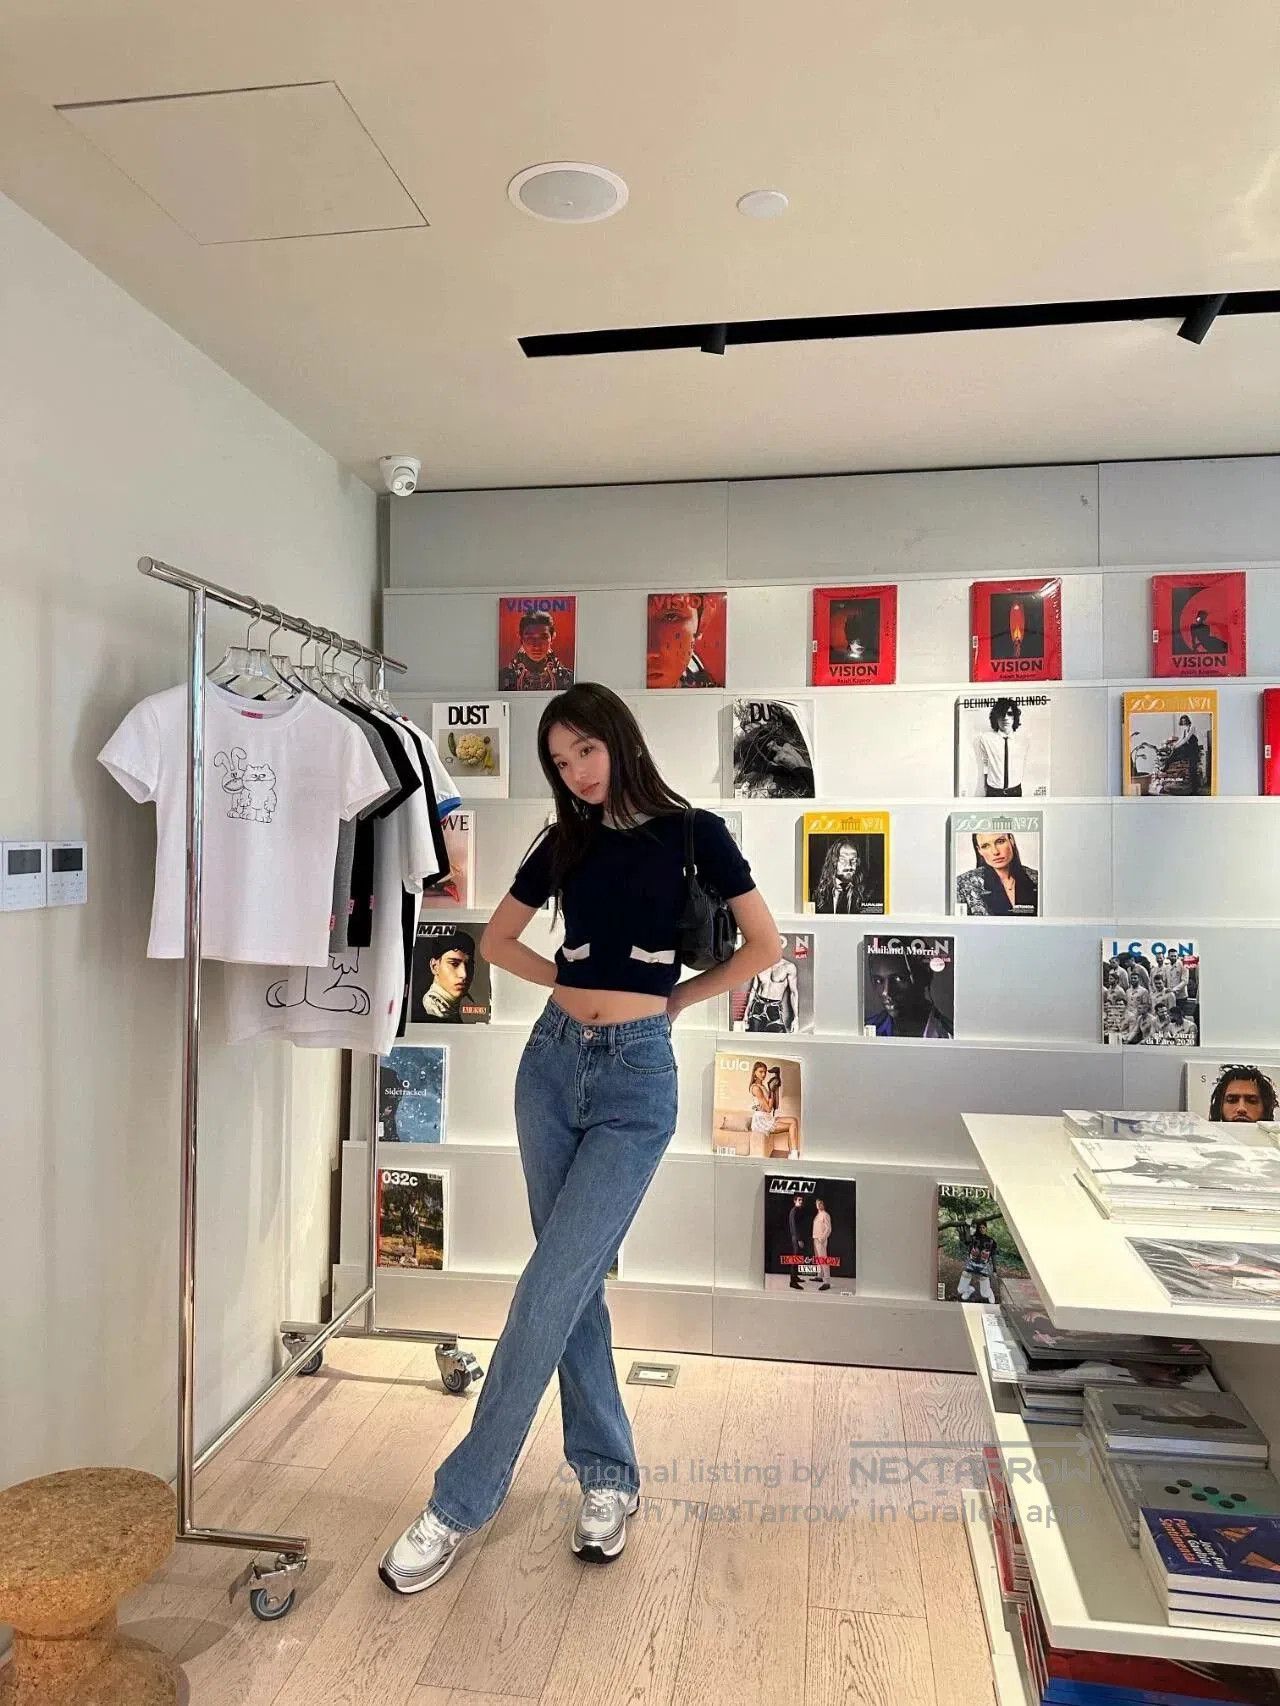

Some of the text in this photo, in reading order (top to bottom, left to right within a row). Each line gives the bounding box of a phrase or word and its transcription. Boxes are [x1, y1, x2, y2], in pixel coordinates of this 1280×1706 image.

[507, 599, 567, 613] VISION
[990, 659, 1043, 673] VISION
[1171, 656, 1227, 668] VISION
[829, 665, 878, 677] VISION
[1015, 695, 1047, 707] BLINDS
[448, 705, 489, 725] DUST
[441, 814, 469, 831] WE
[418, 925, 455, 936] MAN
[873, 937, 949, 954] ICON
[906, 945, 939, 956] Morris
[1112, 941, 1194, 958] ICON
[384, 1087, 427, 1097] Sidetracked
[382, 1171, 419, 1187] 032c
[770, 1179, 816, 1193] MAN
